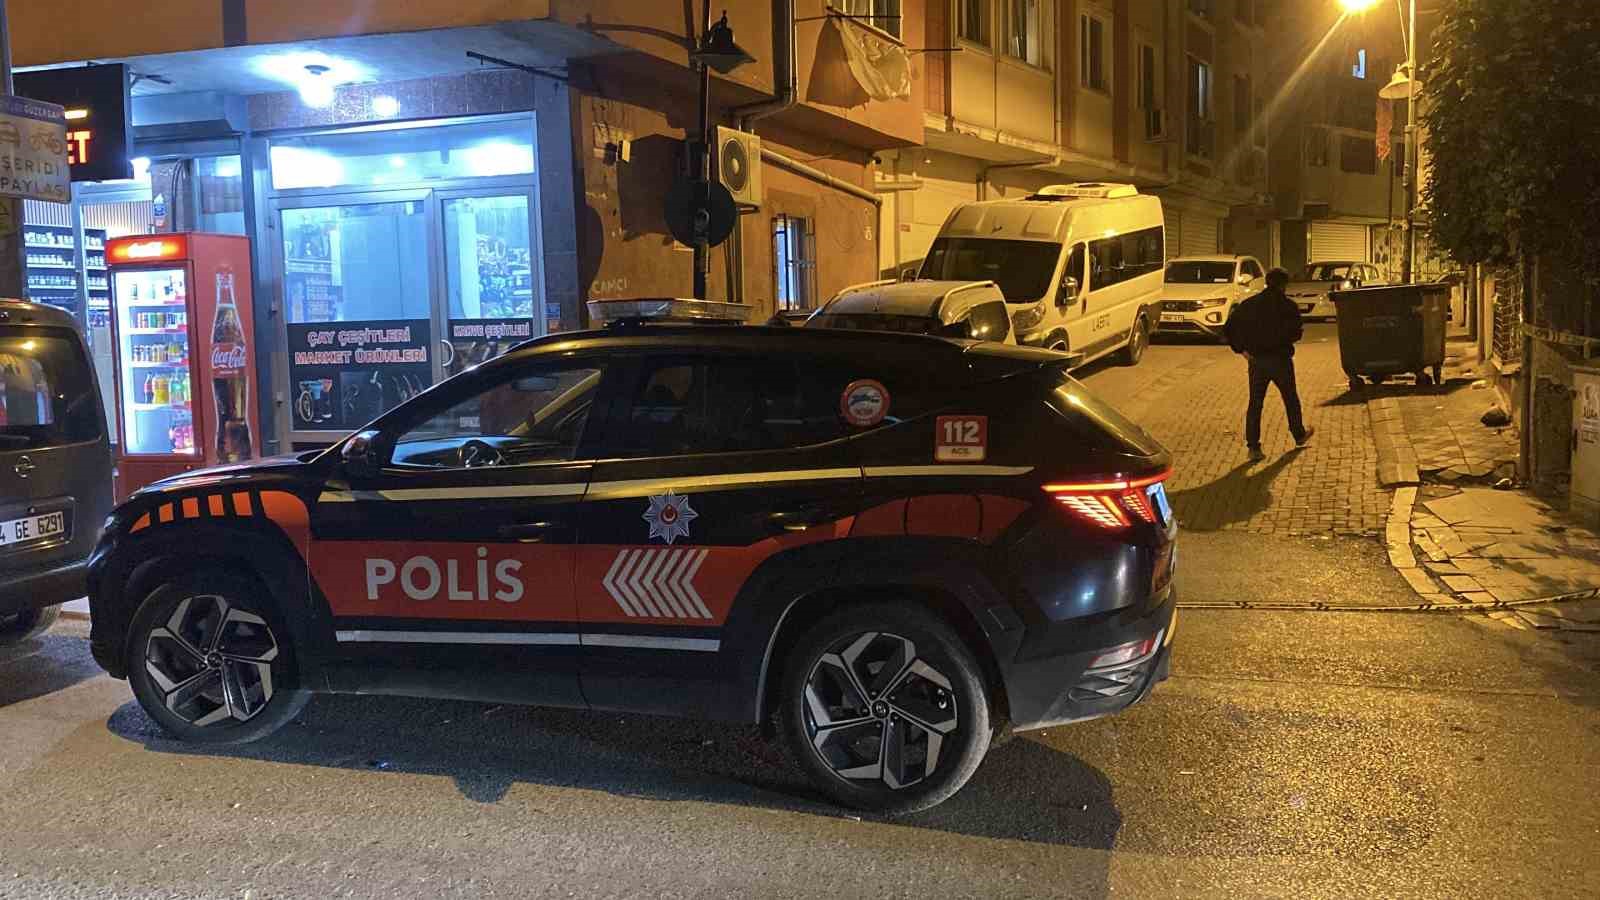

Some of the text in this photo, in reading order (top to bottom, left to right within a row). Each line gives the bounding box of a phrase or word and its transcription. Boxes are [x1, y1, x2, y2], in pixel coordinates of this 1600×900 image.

[307, 331, 336, 348] ÇAY
[211, 345, 247, 369] Coca-Cola
[294, 346, 427, 365] MARKET ÜRÜNLERİ
[943, 420, 979, 443] 112
[15, 520, 30, 540] GE
[365, 546, 524, 602] POLİS
